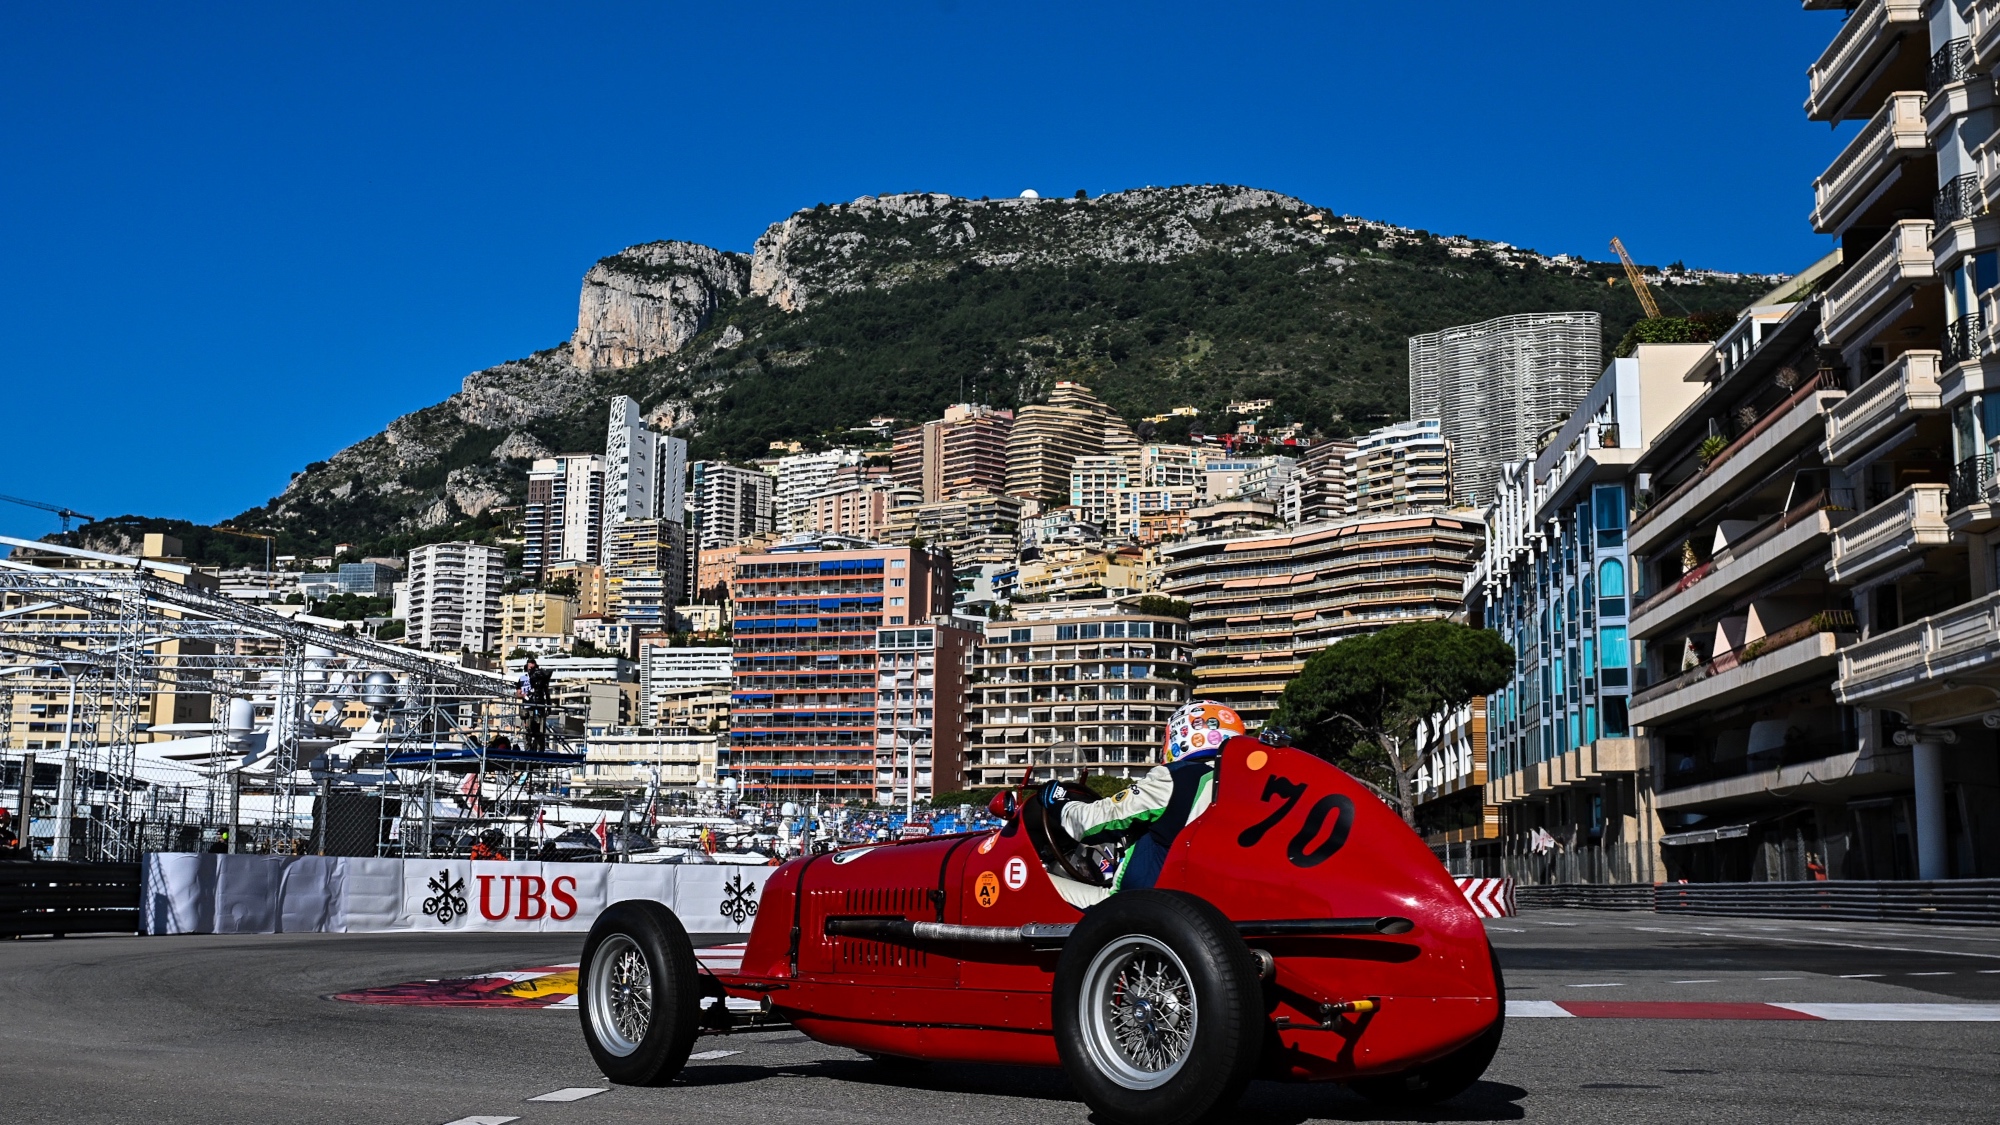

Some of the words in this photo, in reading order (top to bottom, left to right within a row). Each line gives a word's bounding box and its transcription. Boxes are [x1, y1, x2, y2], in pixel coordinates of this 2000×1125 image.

[1237, 773, 1355, 868] 70
[1010, 863, 1021, 883] E
[476, 875, 578, 920] UBS
[983, 898, 991, 906] 64
